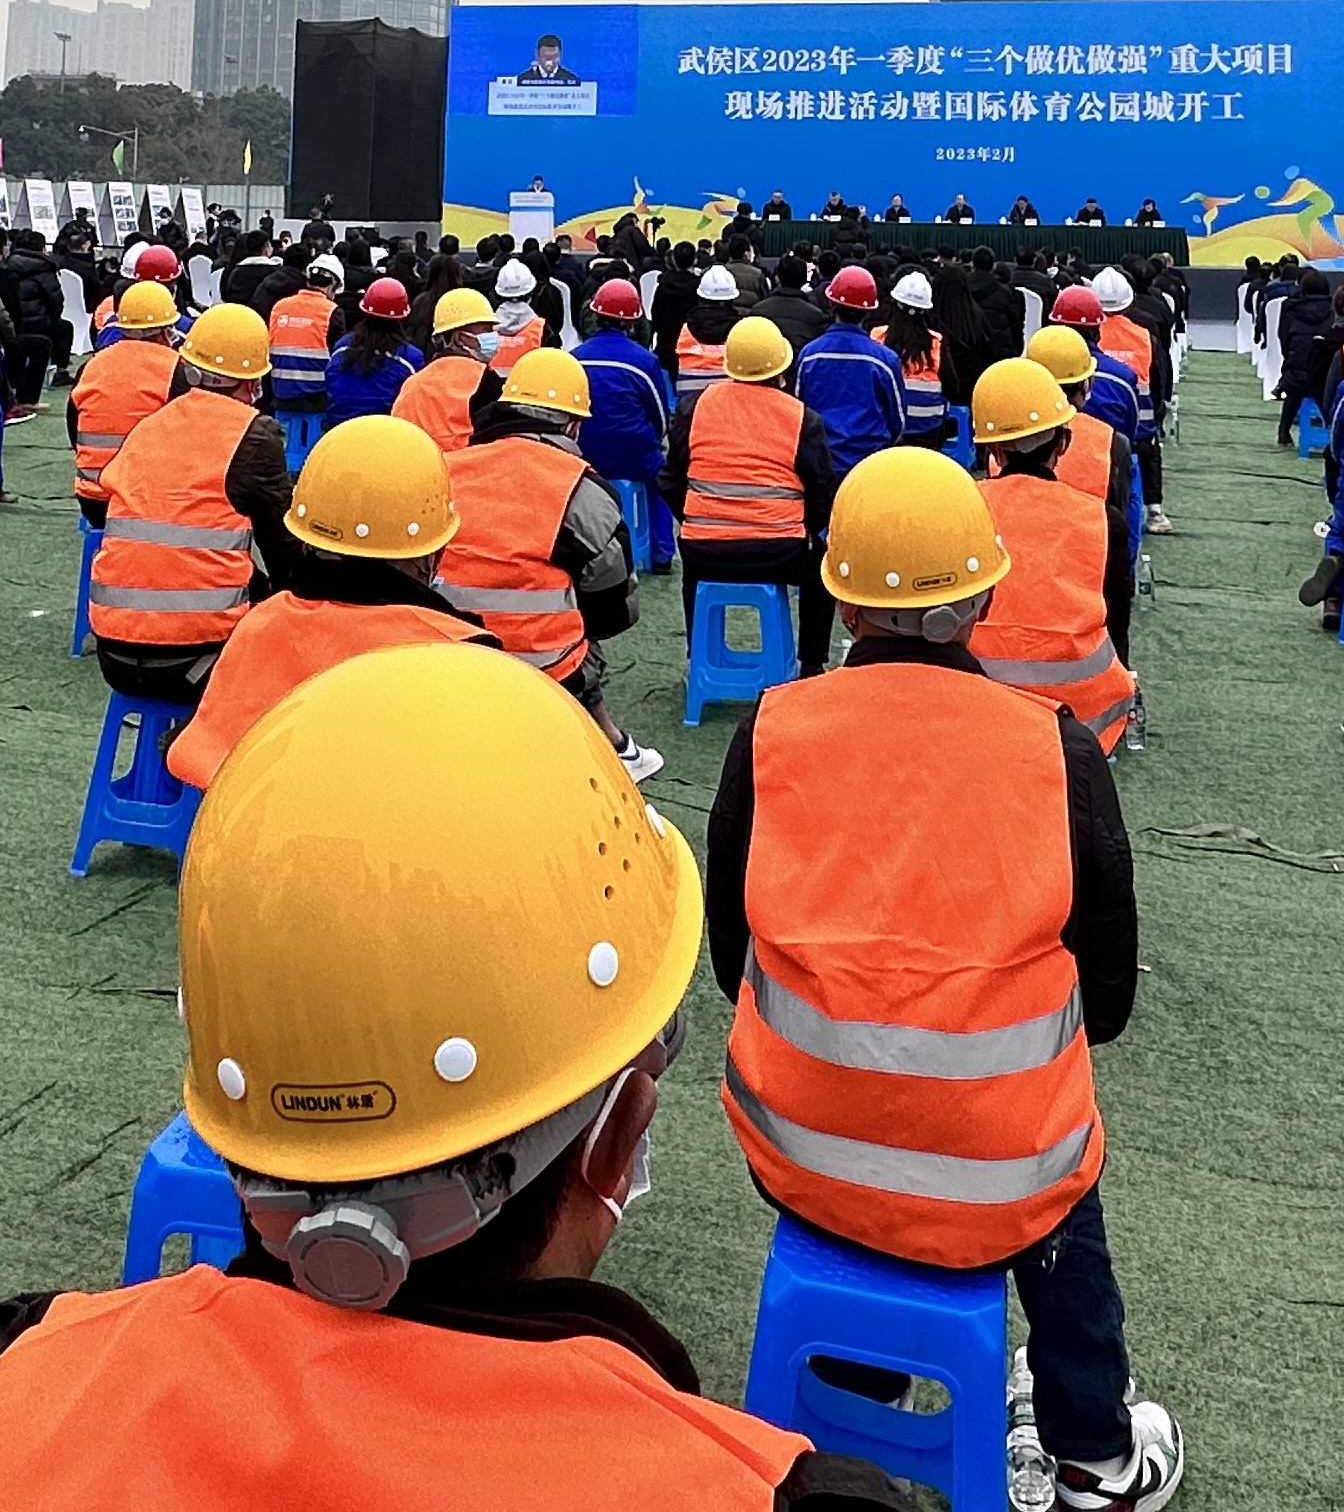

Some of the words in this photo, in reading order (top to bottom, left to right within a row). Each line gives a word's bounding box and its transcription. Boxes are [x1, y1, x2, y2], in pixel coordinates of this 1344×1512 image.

[724, 91, 1244, 122] 现场推进活动暨国际体育公园城开工
[936, 147, 1015, 163] 2023年2月
[281, 1094, 342, 1112] LINDUN
